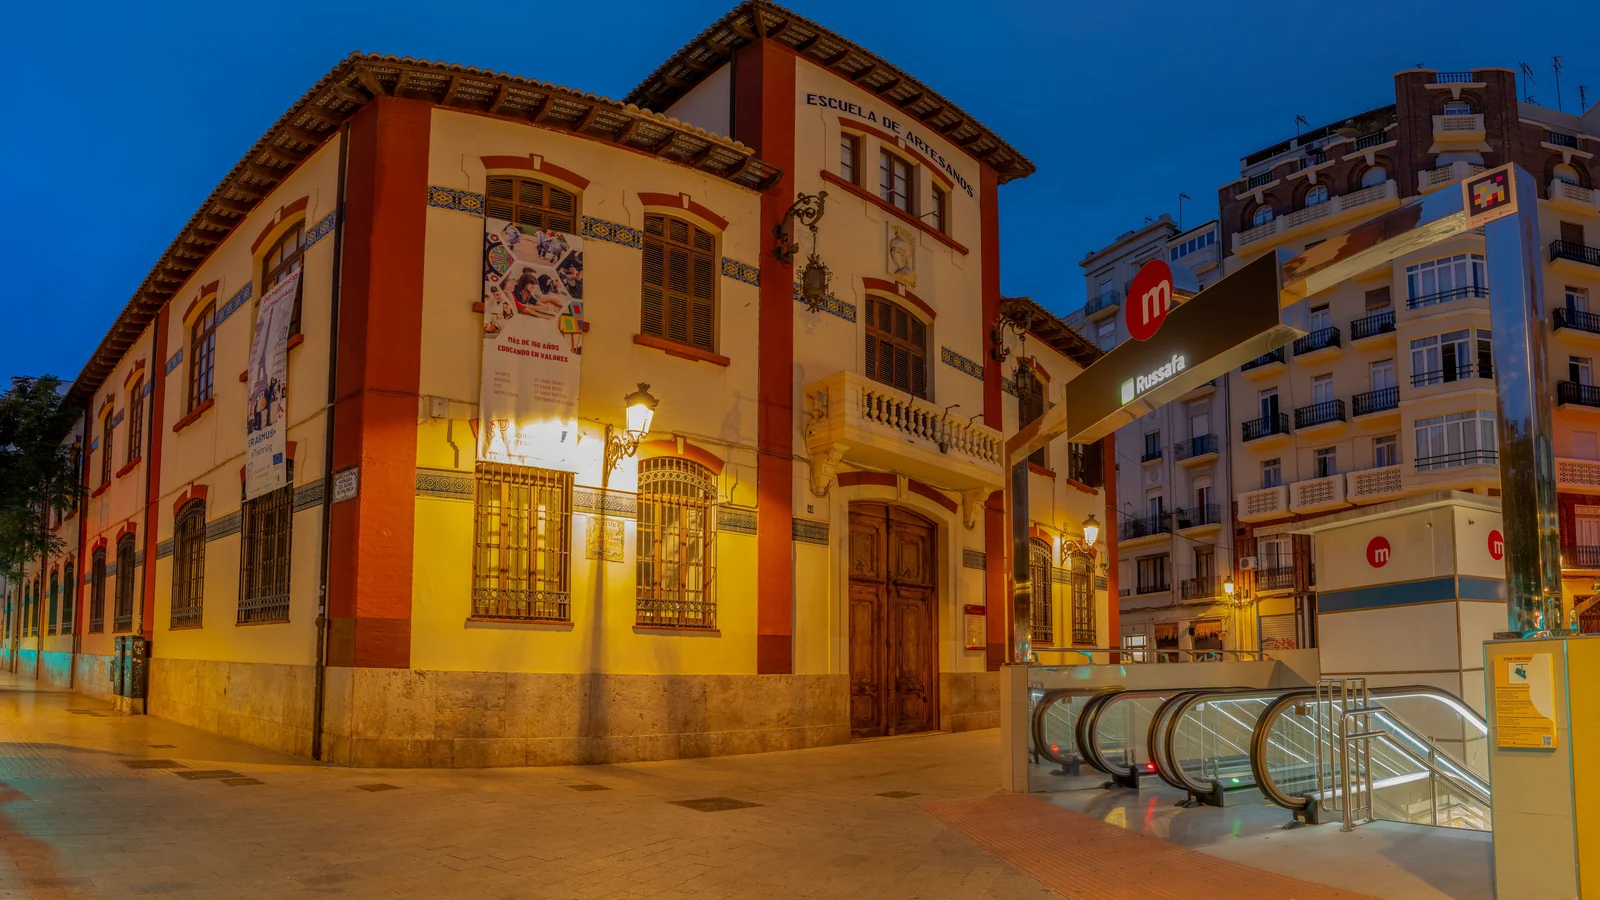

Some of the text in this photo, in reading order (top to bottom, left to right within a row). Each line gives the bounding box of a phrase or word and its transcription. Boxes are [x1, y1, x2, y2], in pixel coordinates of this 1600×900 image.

[806, 94, 973, 198] ESCUELA DE ARTESANOS
[1142, 279, 1170, 326] m
[508, 336, 520, 344] MÁS
[542, 342, 559, 351] AÑOS
[498, 345, 530, 356] EDUCANDO
[540, 353, 568, 362] VALORES
[1136, 354, 1185, 394] Russafa
[248, 429, 276, 447] ERASMUS+
[1375, 548, 1389, 563] m
